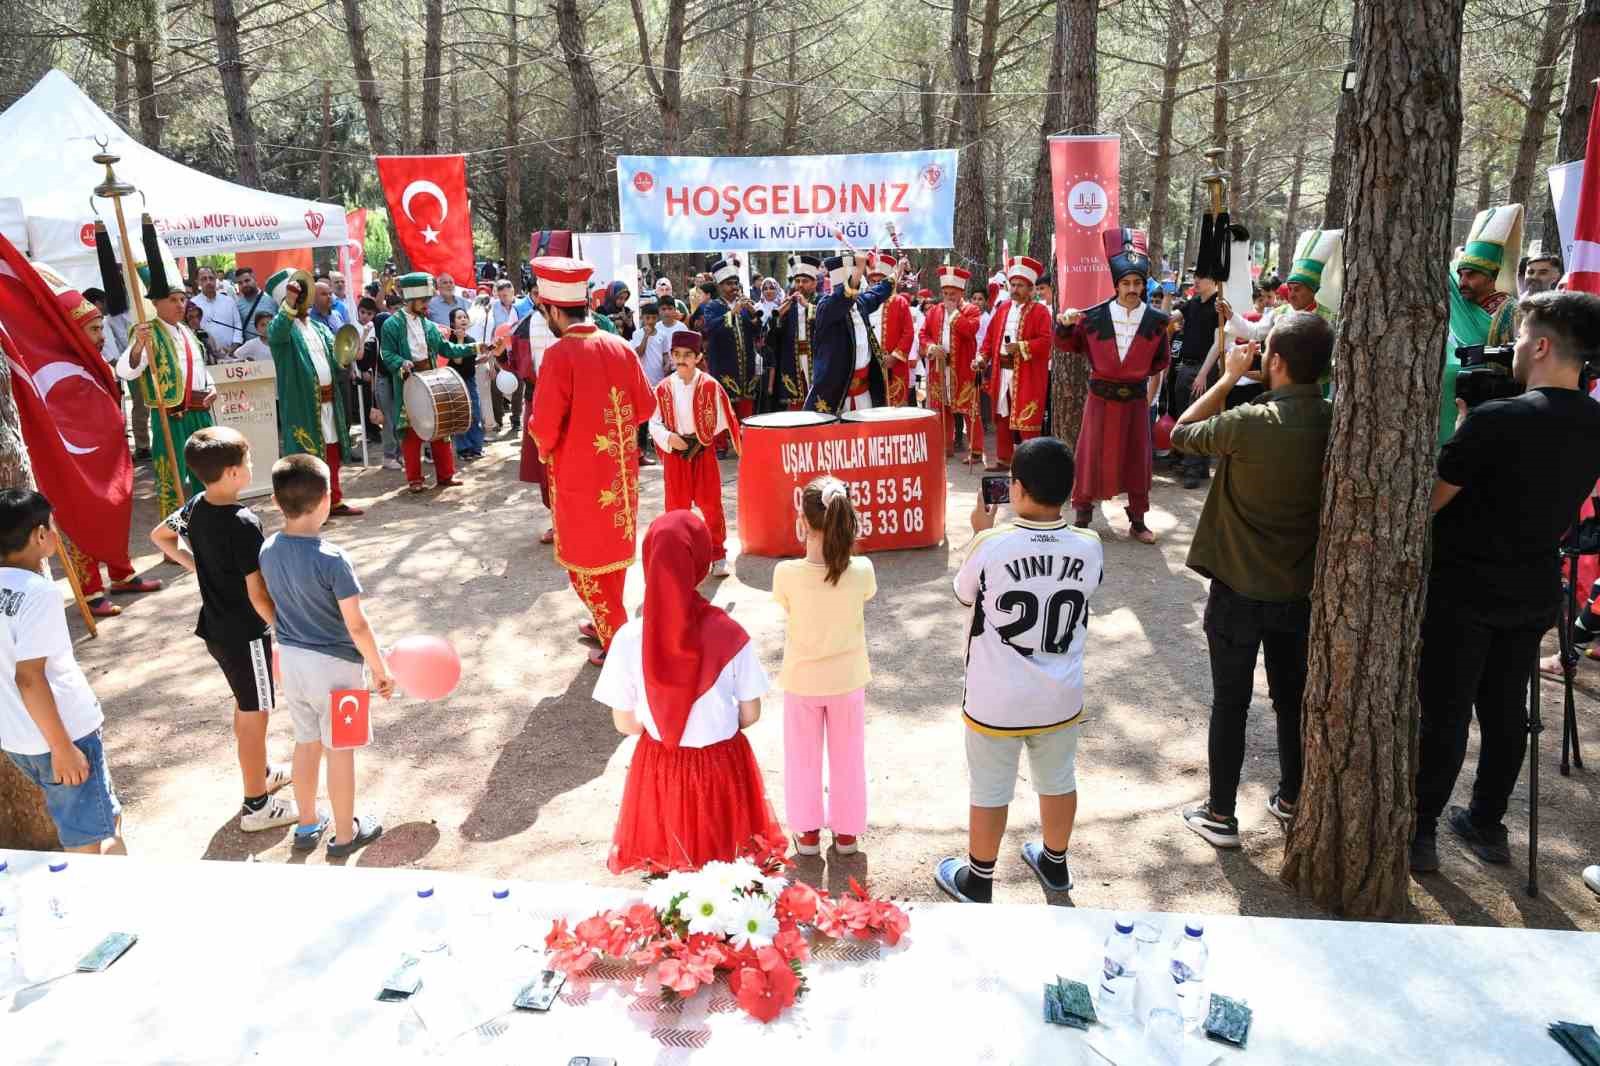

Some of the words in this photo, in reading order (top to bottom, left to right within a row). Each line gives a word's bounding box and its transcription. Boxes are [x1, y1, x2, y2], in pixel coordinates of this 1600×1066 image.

[665, 182, 910, 223] HOŞGELDİNİZ
[708, 225, 751, 242] UŞAK
[753, 223, 767, 240] İL
[781, 443, 815, 481] UŞAK
[818, 438, 866, 475] AŞIKLAR
[868, 432, 928, 467] MEHTERAN
[876, 478, 897, 505] 53
[902, 475, 922, 503] 54
[878, 509, 899, 535] 33
[903, 507, 924, 533] 08
[1004, 555, 1053, 582] VINI
[1056, 556, 1085, 582] JR.
[995, 589, 1085, 658] 20
